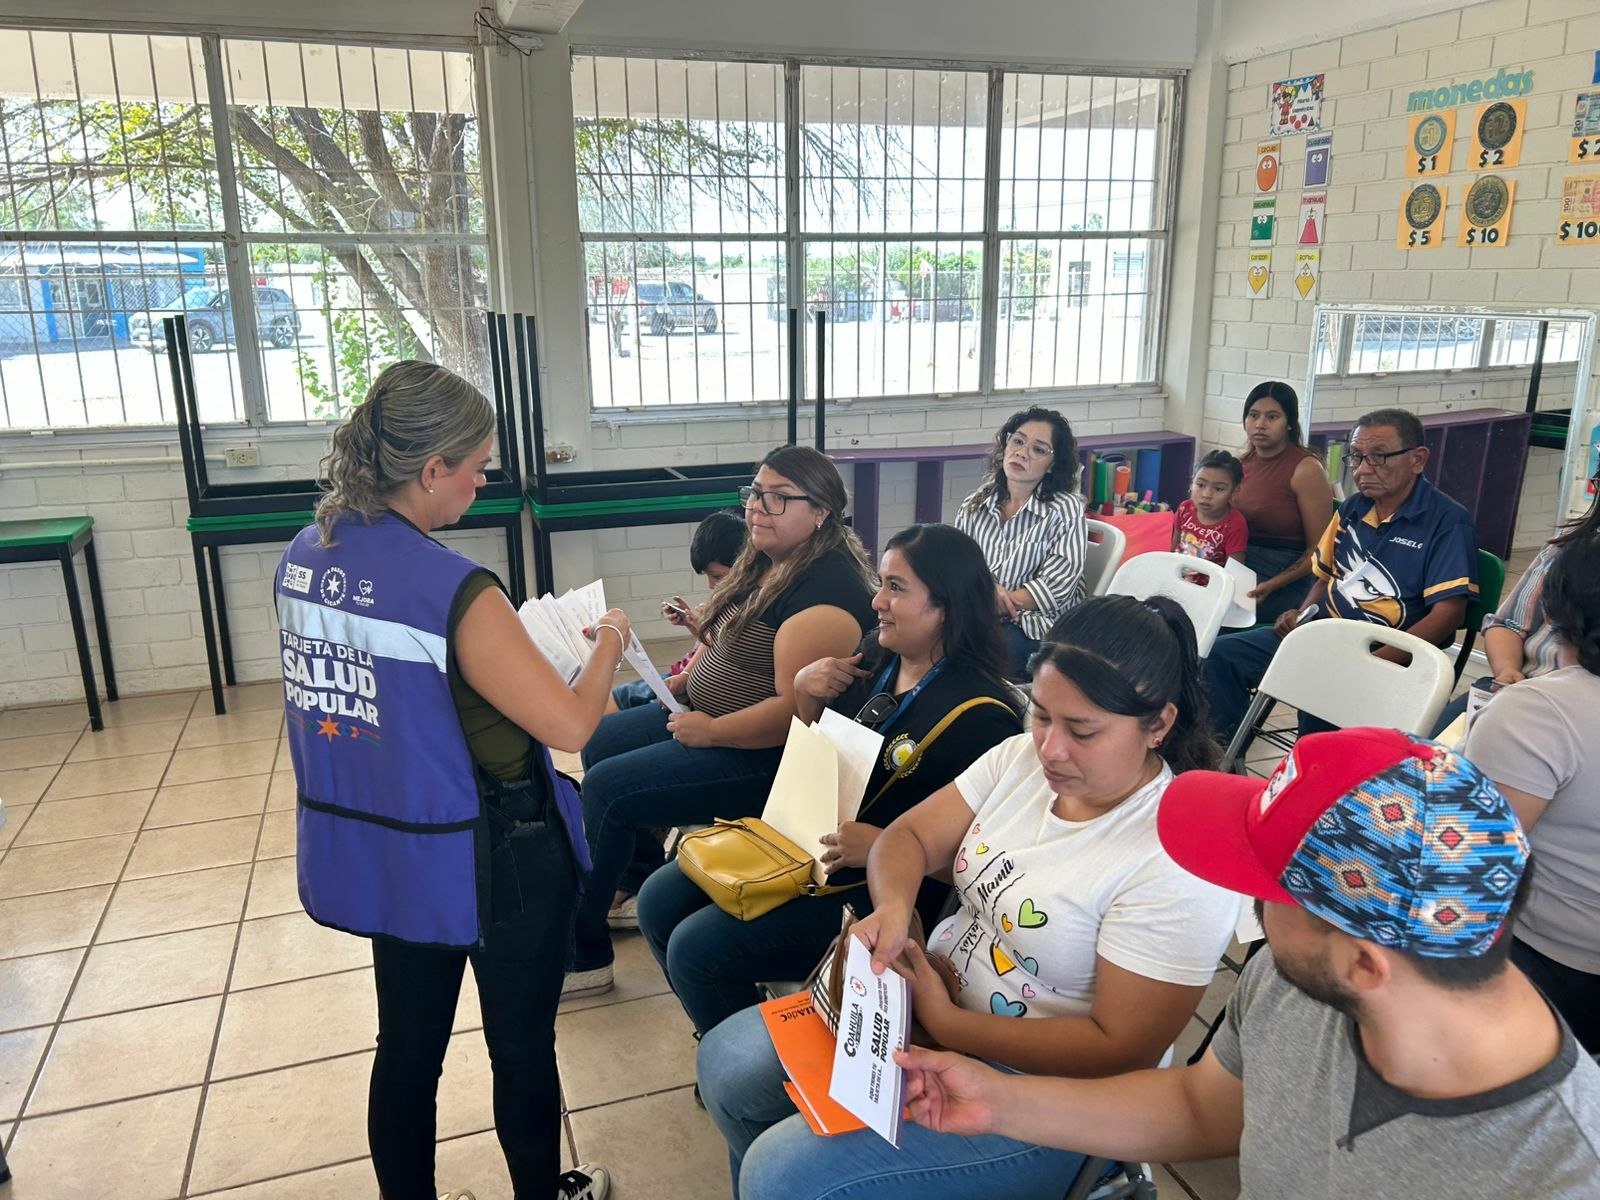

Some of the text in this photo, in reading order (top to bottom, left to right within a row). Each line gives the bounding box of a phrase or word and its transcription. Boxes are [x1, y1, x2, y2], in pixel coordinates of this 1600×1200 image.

[1407, 68, 1535, 112] monedas
[1577, 221, 1600, 238] 10
[298, 570, 307, 580] SS
[281, 630, 375, 669] TARJETA DE LA
[283, 648, 377, 700] SALUD
[284, 680, 380, 727] POPULAR
[976, 858, 1015, 913] Mamá
[960, 921, 985, 954] arlos
[844, 1003, 859, 1057] COAHUILA
[871, 1011, 883, 1057] SALUD
[880, 1019, 890, 1063] POPULAR
